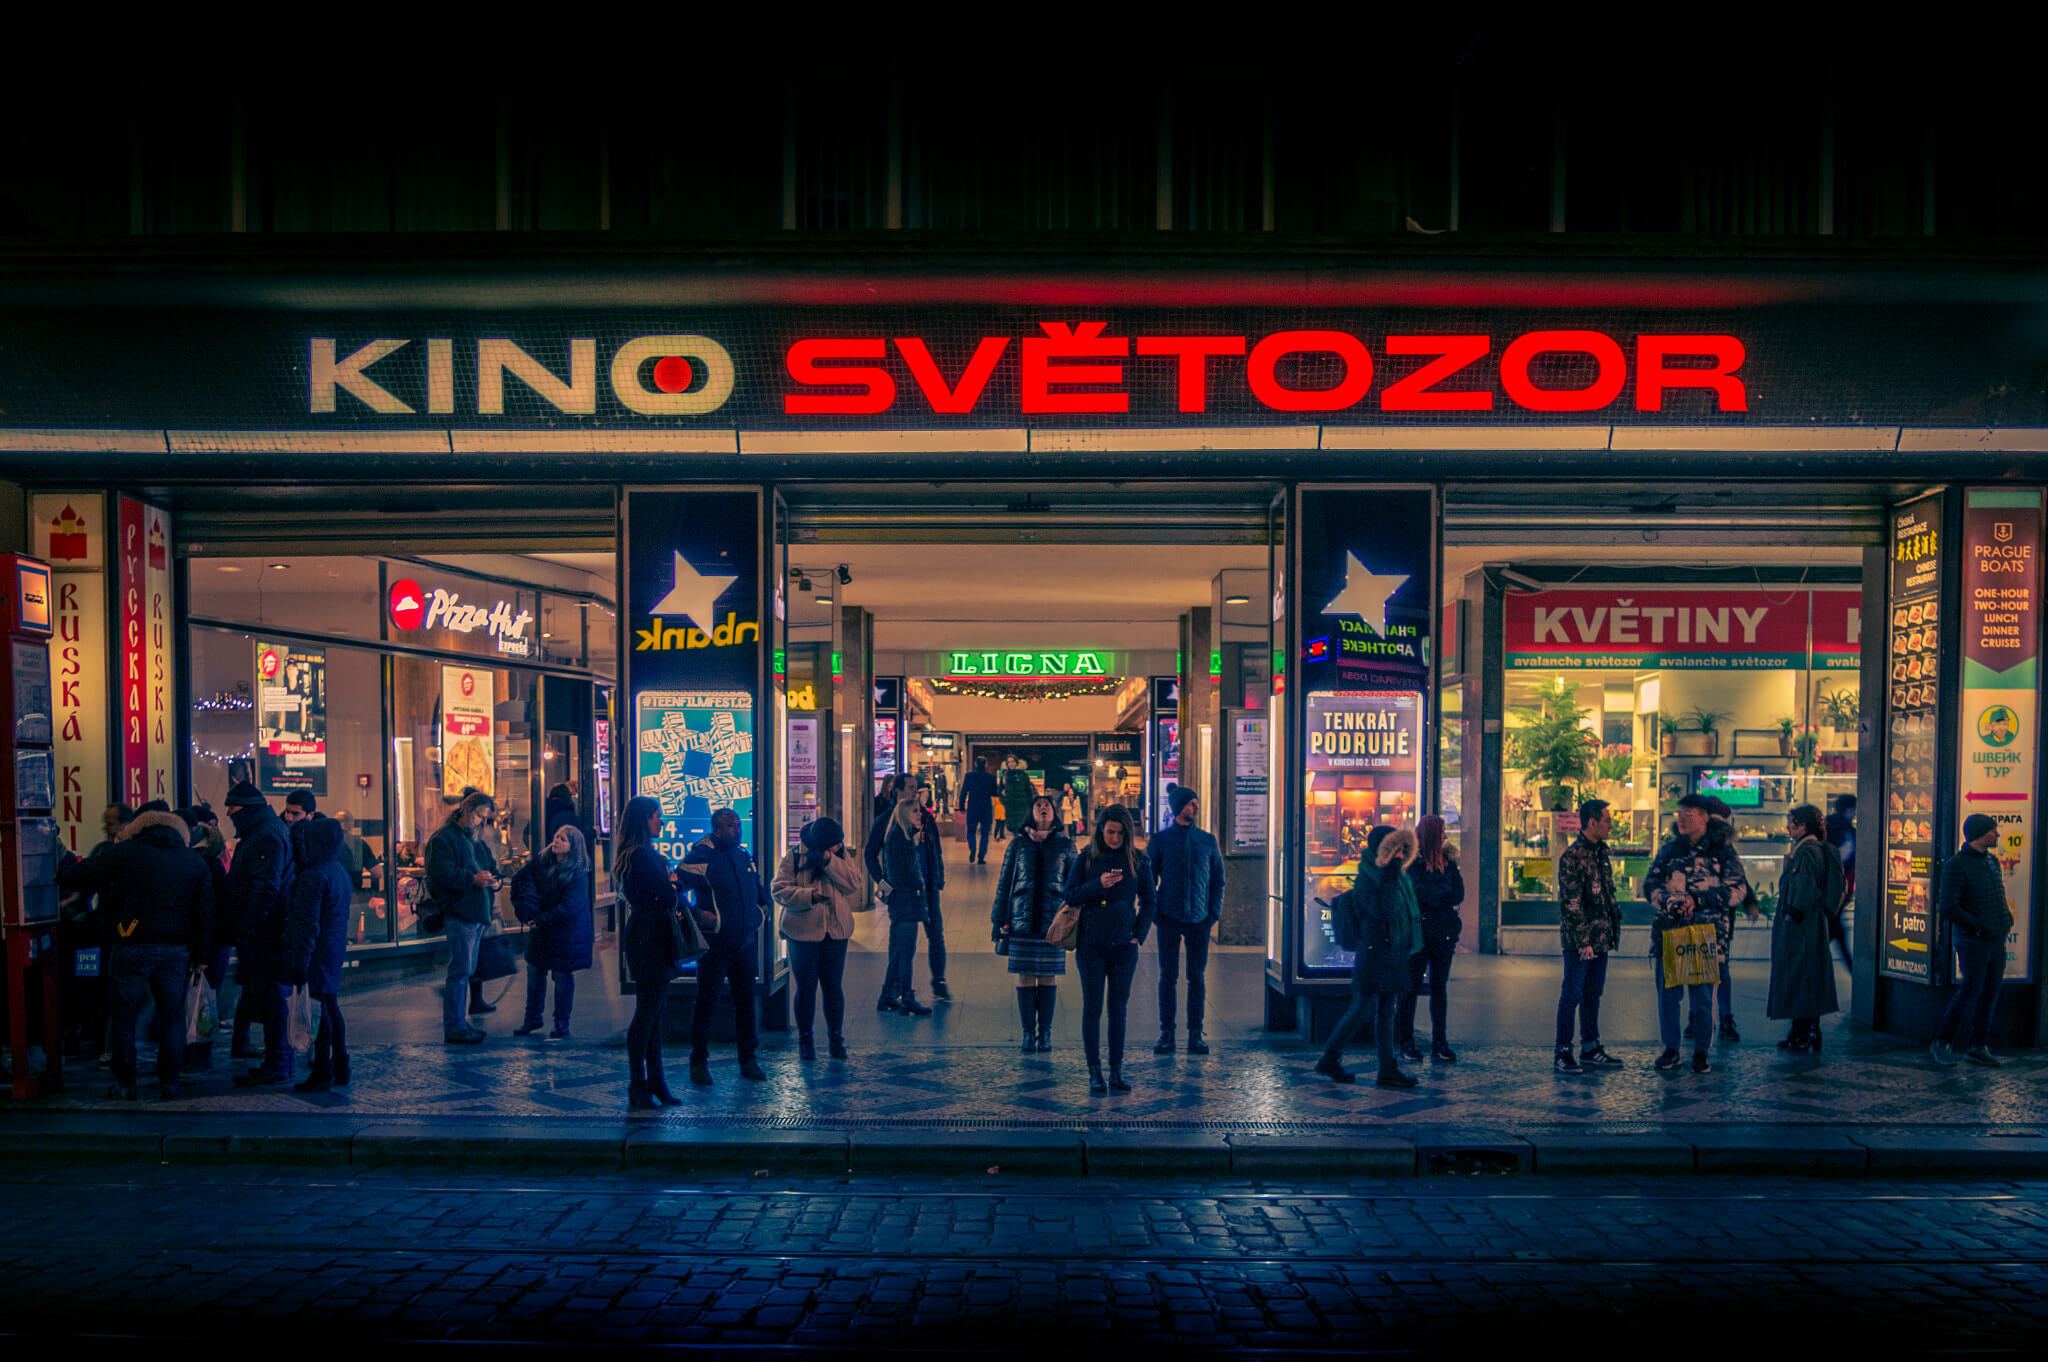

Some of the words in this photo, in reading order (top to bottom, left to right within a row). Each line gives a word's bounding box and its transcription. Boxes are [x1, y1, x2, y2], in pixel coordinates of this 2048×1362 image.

[309, 334, 735, 415] KINO
[784, 321, 1748, 414] SVĚTOZOR
[1974, 545, 2031, 558] PRAGUE
[1980, 560, 2024, 572] BOATS
[1974, 588, 2029, 598] ONE-HOUR
[426, 588, 489, 633] Pizza
[489, 600, 533, 639] Hut
[1973, 601, 2029, 610] TWO-HOUR
[1533, 598, 1769, 643] KVĚTINY
[1984, 614, 2018, 623] LUNCH
[127, 524, 141, 743] РУССКАЯ
[1982, 626, 2020, 635] DINNER
[1981, 638, 2020, 648] CRUISES
[60, 583, 82, 741] RUSKÁ
[153, 593, 164, 744] RUSKÁ
[950, 652, 1105, 675] LIGNA
[1513, 656, 1582, 667] avalanche
[1584, 656, 1644, 667] světozor
[1660, 656, 1728, 667] avalanche
[1731, 656, 1788, 667] světozor
[1323, 710, 1397, 730] TENKRÁT
[1098, 740, 1131, 752] TRDELNÍK
[1311, 728, 1408, 755] PODRUHÉ
[1972, 749, 2021, 763] ШВЕЙК
[1894, 912, 1902, 929] 1.
[1902, 915, 1926, 933] patro
